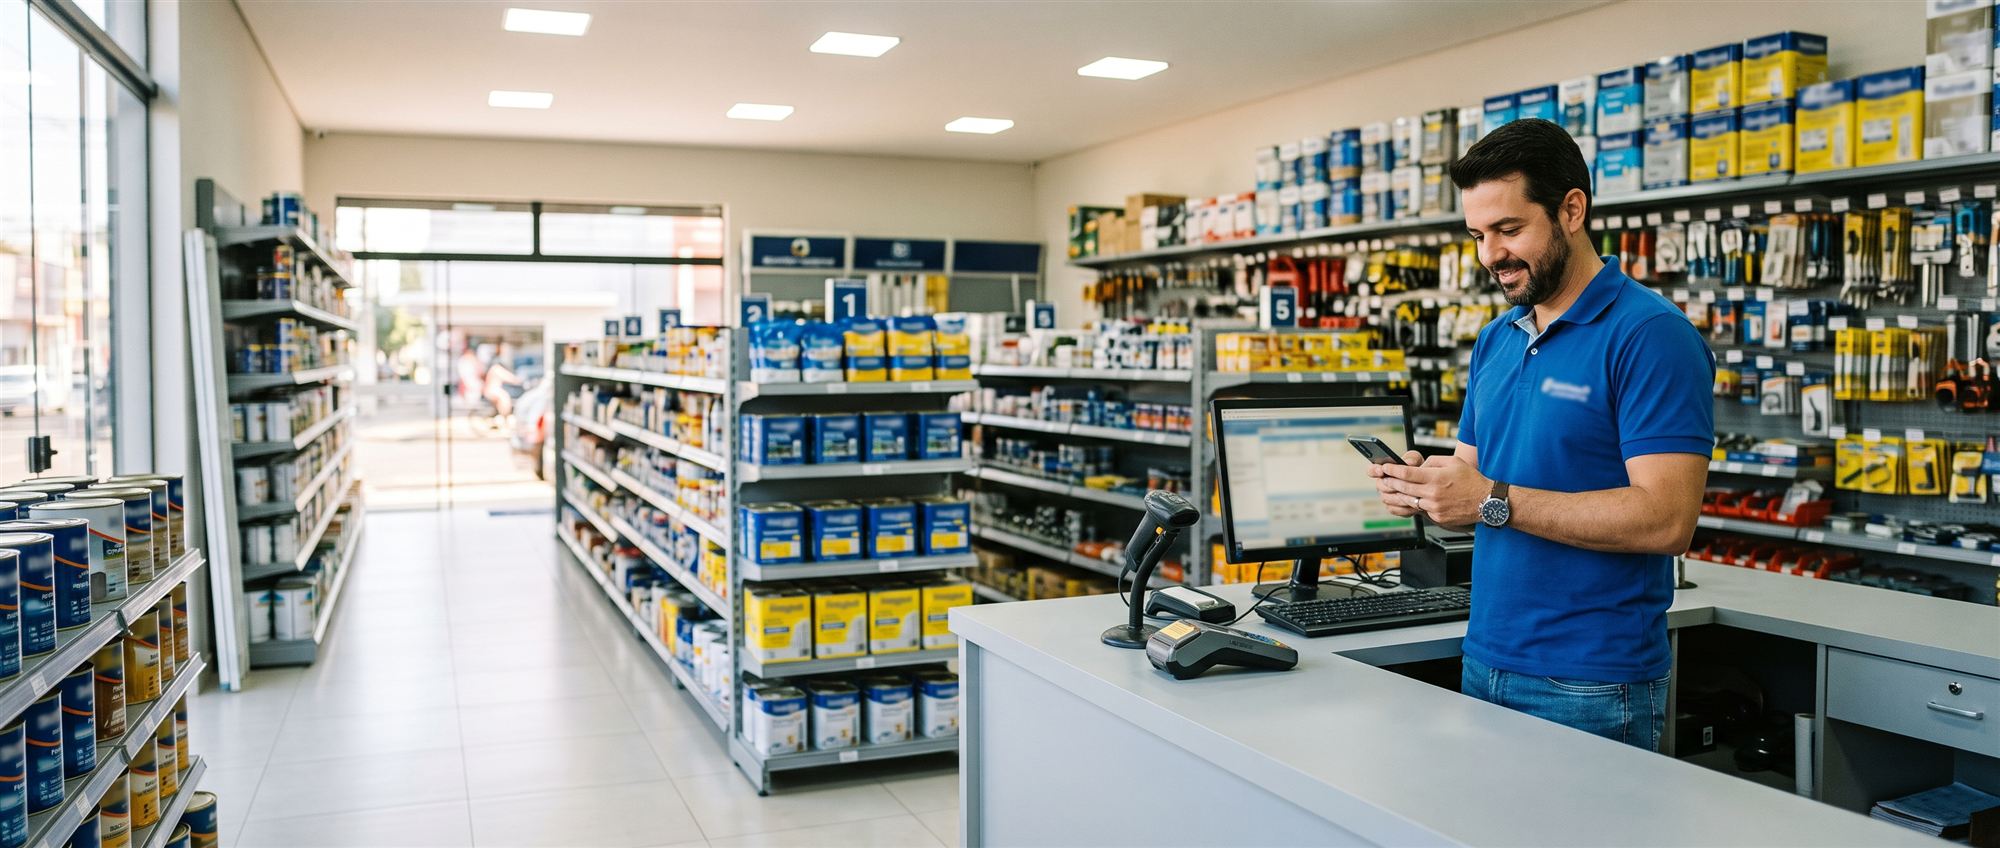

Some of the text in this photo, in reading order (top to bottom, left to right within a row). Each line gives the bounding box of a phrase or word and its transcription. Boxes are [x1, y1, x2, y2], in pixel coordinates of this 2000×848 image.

[746, 304, 762, 323] 2
[842, 293, 856, 317] 1
[1275, 298, 1290, 320] 5
